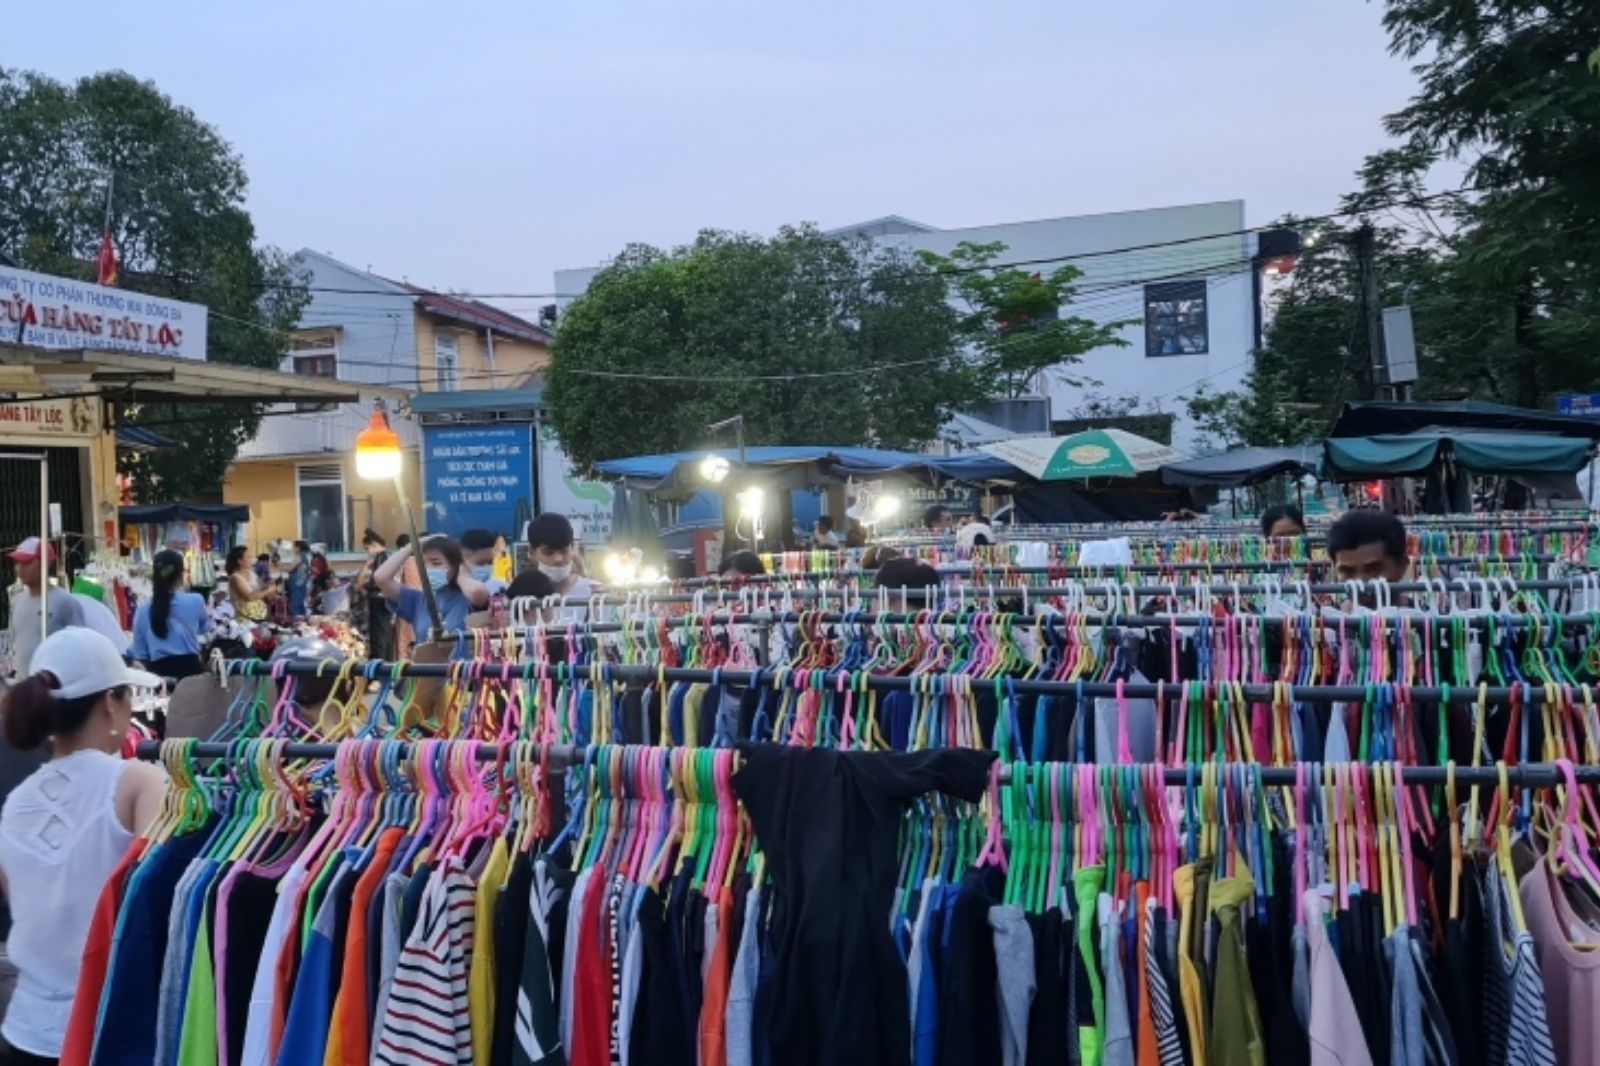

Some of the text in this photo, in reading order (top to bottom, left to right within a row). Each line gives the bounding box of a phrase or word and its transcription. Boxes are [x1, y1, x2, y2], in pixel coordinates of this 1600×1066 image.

[42, 304, 103, 336] HÀNG
[108, 316, 143, 342] TÂY
[146, 323, 182, 349] LỘC
